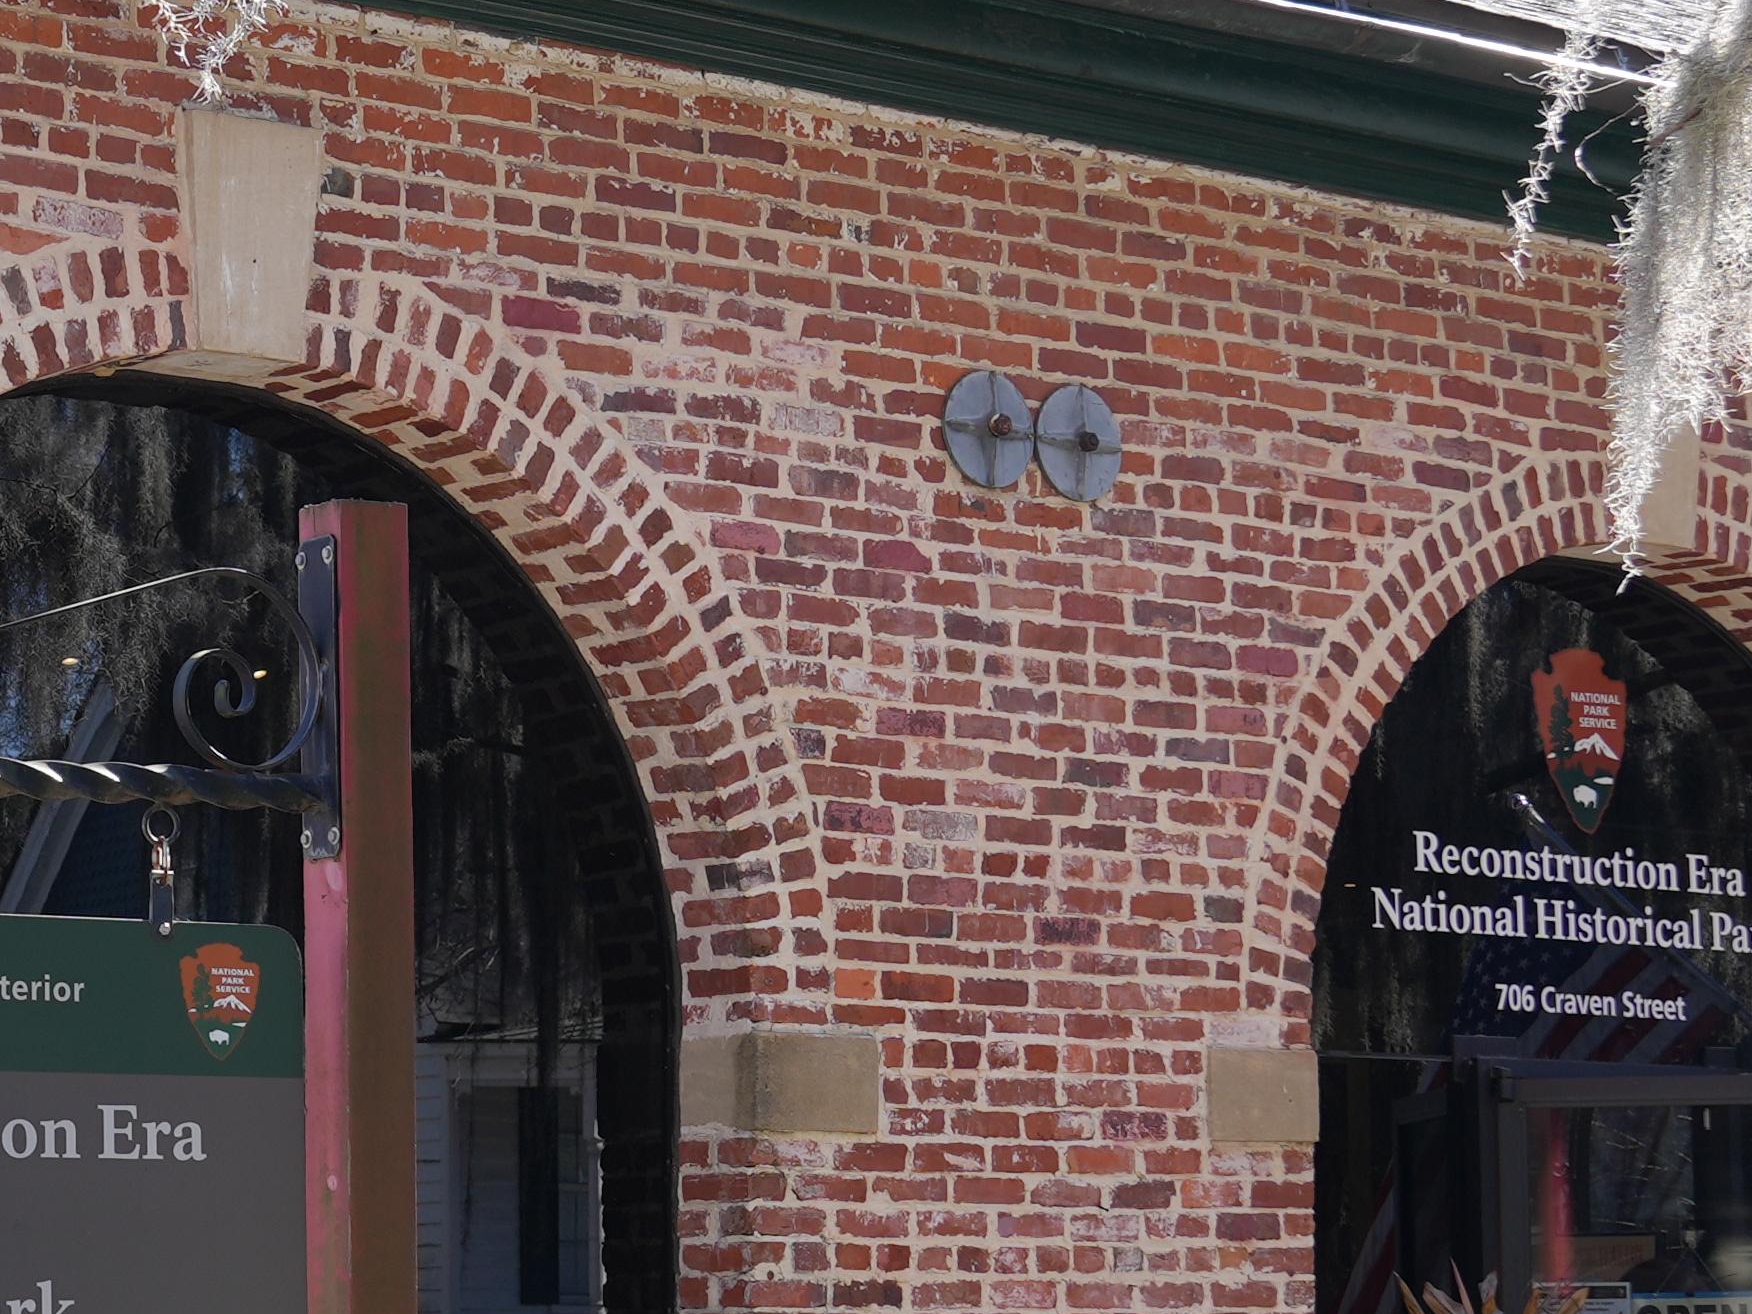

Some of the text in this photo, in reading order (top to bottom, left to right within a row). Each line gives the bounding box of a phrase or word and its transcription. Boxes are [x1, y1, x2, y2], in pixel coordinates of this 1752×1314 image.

[1571, 692, 1621, 705] NATIONAL
[1584, 705, 1610, 716] PARK
[1579, 717, 1617, 729] SERVICE
[1413, 831, 1745, 896] Reconstruction Era
[1371, 887, 1527, 937] National
[1534, 899, 1703, 949] Historical
[211, 967, 254, 976] NATIONAL
[216, 986, 250, 994] SERVICE
[1495, 984, 1686, 1020] 706 Craven Street
[98, 1105, 207, 1160] Era
